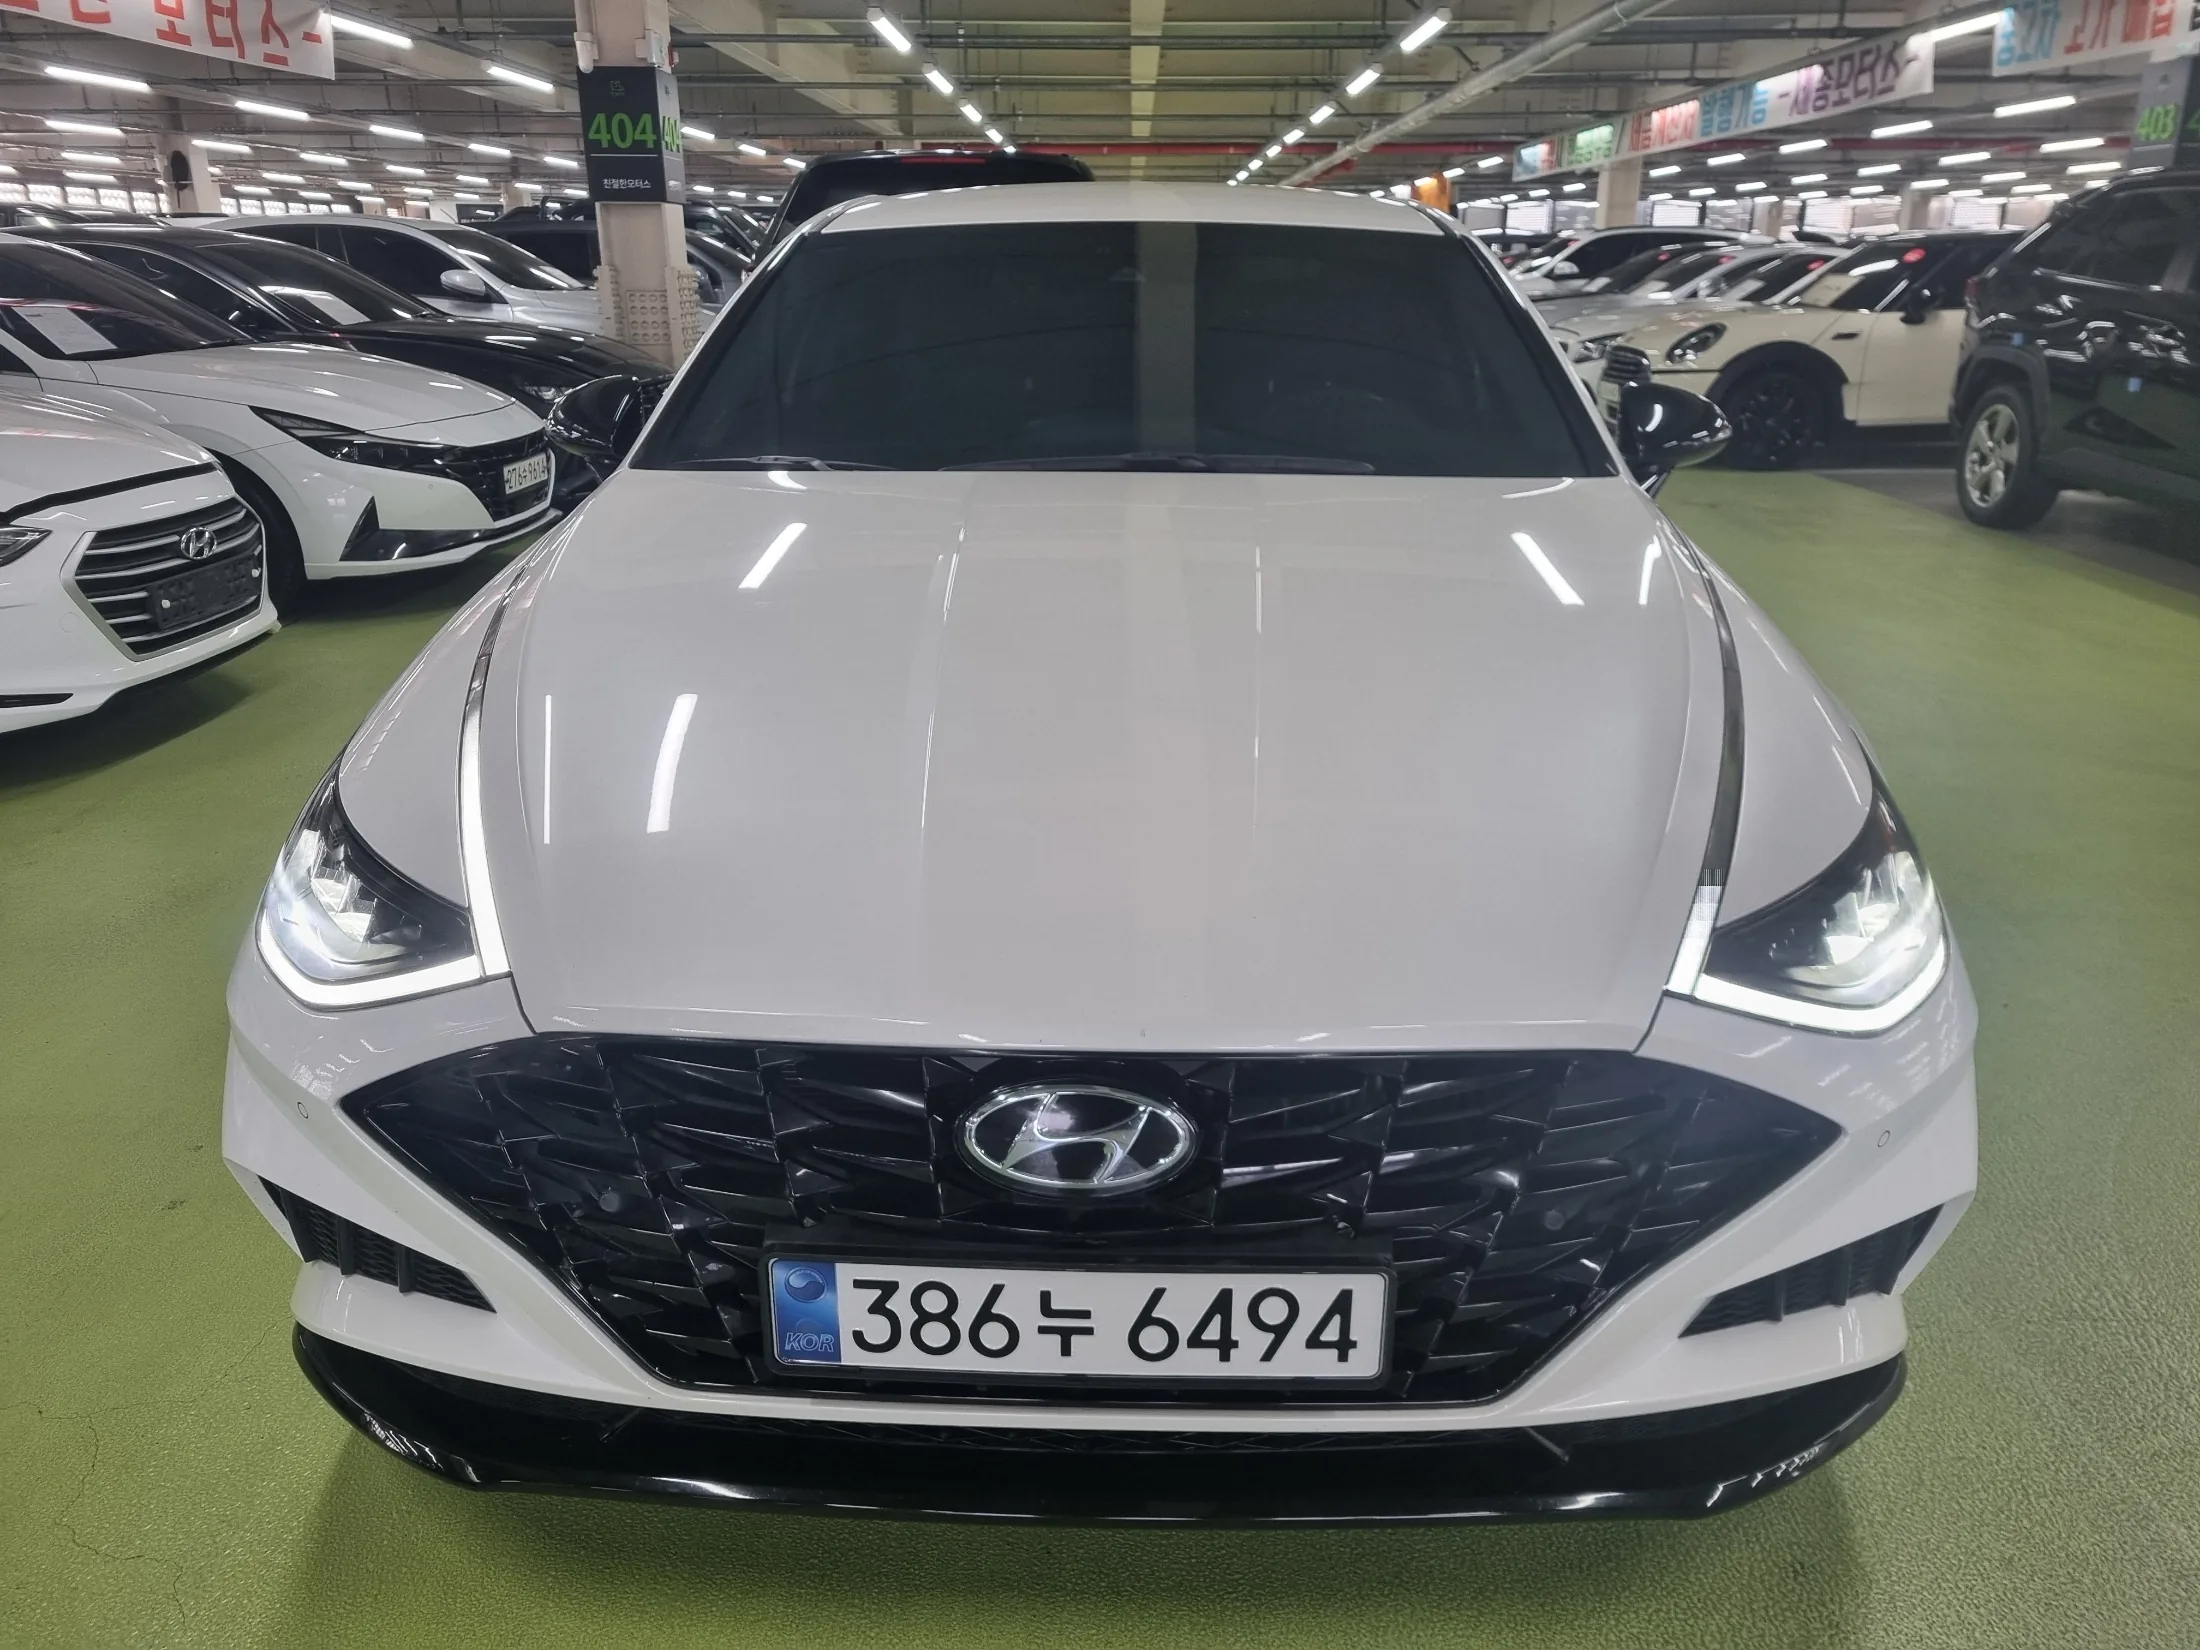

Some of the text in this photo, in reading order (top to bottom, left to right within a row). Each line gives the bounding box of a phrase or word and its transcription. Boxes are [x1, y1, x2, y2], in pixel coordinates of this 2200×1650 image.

[588, 112, 657, 149] 404
[2136, 103, 2176, 141] 403
[603, 178, 651, 190] 친절한모터스
[852, 1278, 1357, 1362] 386누 6494
[785, 1333, 835, 1352] KOR
